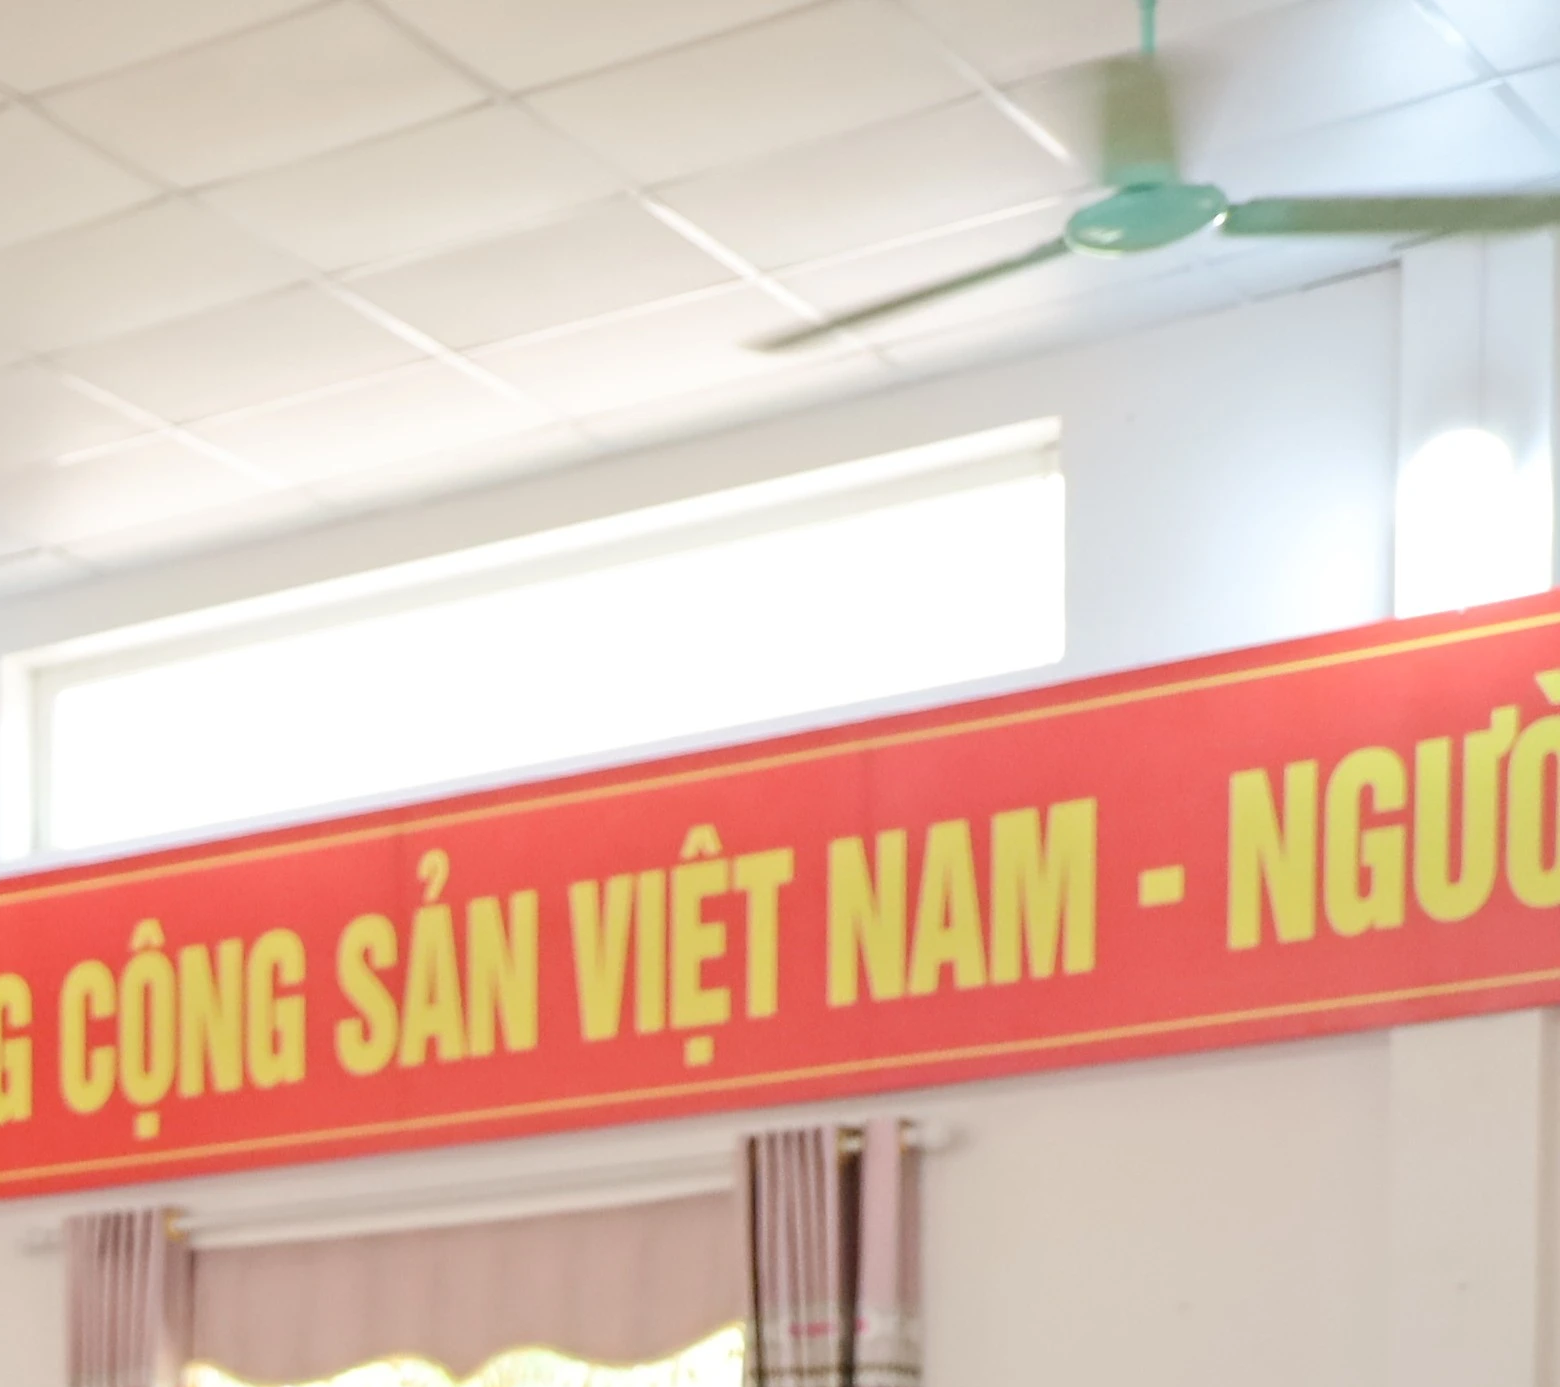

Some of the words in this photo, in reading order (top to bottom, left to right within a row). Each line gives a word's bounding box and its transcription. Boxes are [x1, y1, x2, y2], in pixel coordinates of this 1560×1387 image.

[60, 919, 306, 1139] CỘNG
[335, 849, 538, 1075] SẢN
[569, 824, 794, 1066] VIỆT
[827, 797, 1097, 1008] NAM
